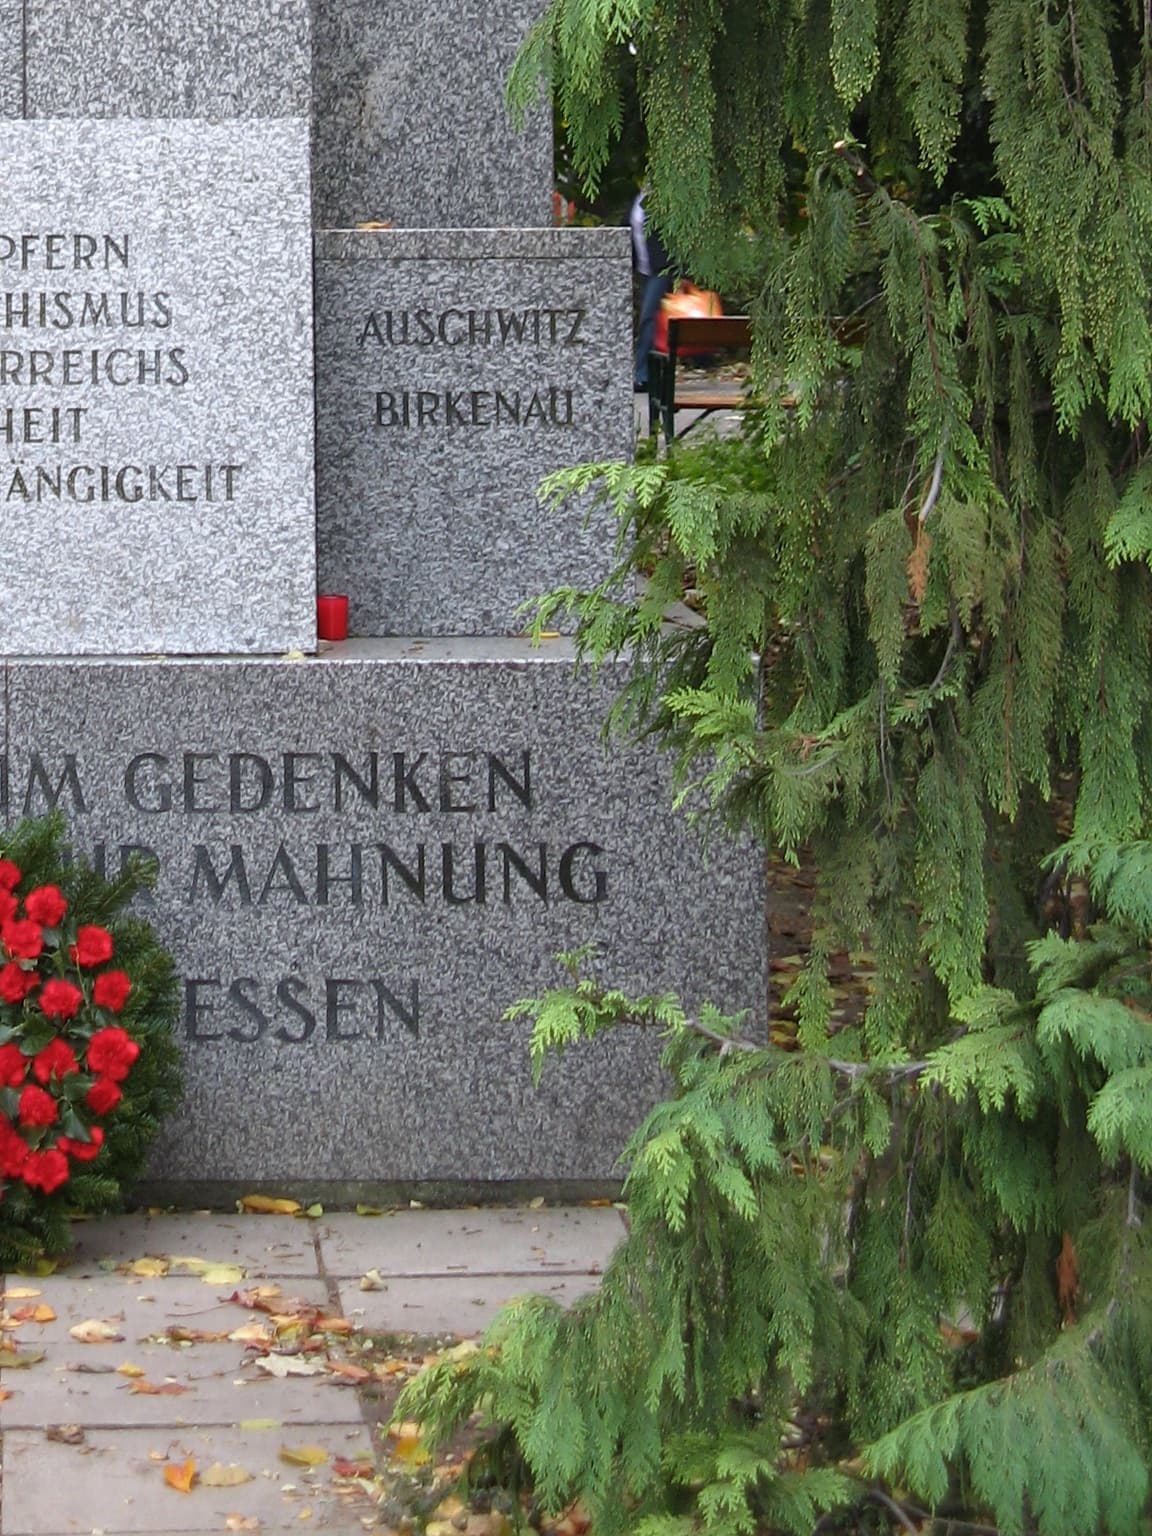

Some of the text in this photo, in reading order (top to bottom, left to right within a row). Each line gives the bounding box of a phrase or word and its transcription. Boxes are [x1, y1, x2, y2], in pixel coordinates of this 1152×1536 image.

[357, 309, 589, 347] AUSCHWITZ
[375, 390, 575, 427] BIRKENAU
[124, 751, 535, 815] GEDENKEN
[188, 843, 610, 905] MAHNUNG
[184, 977, 421, 1043] ESSEN
